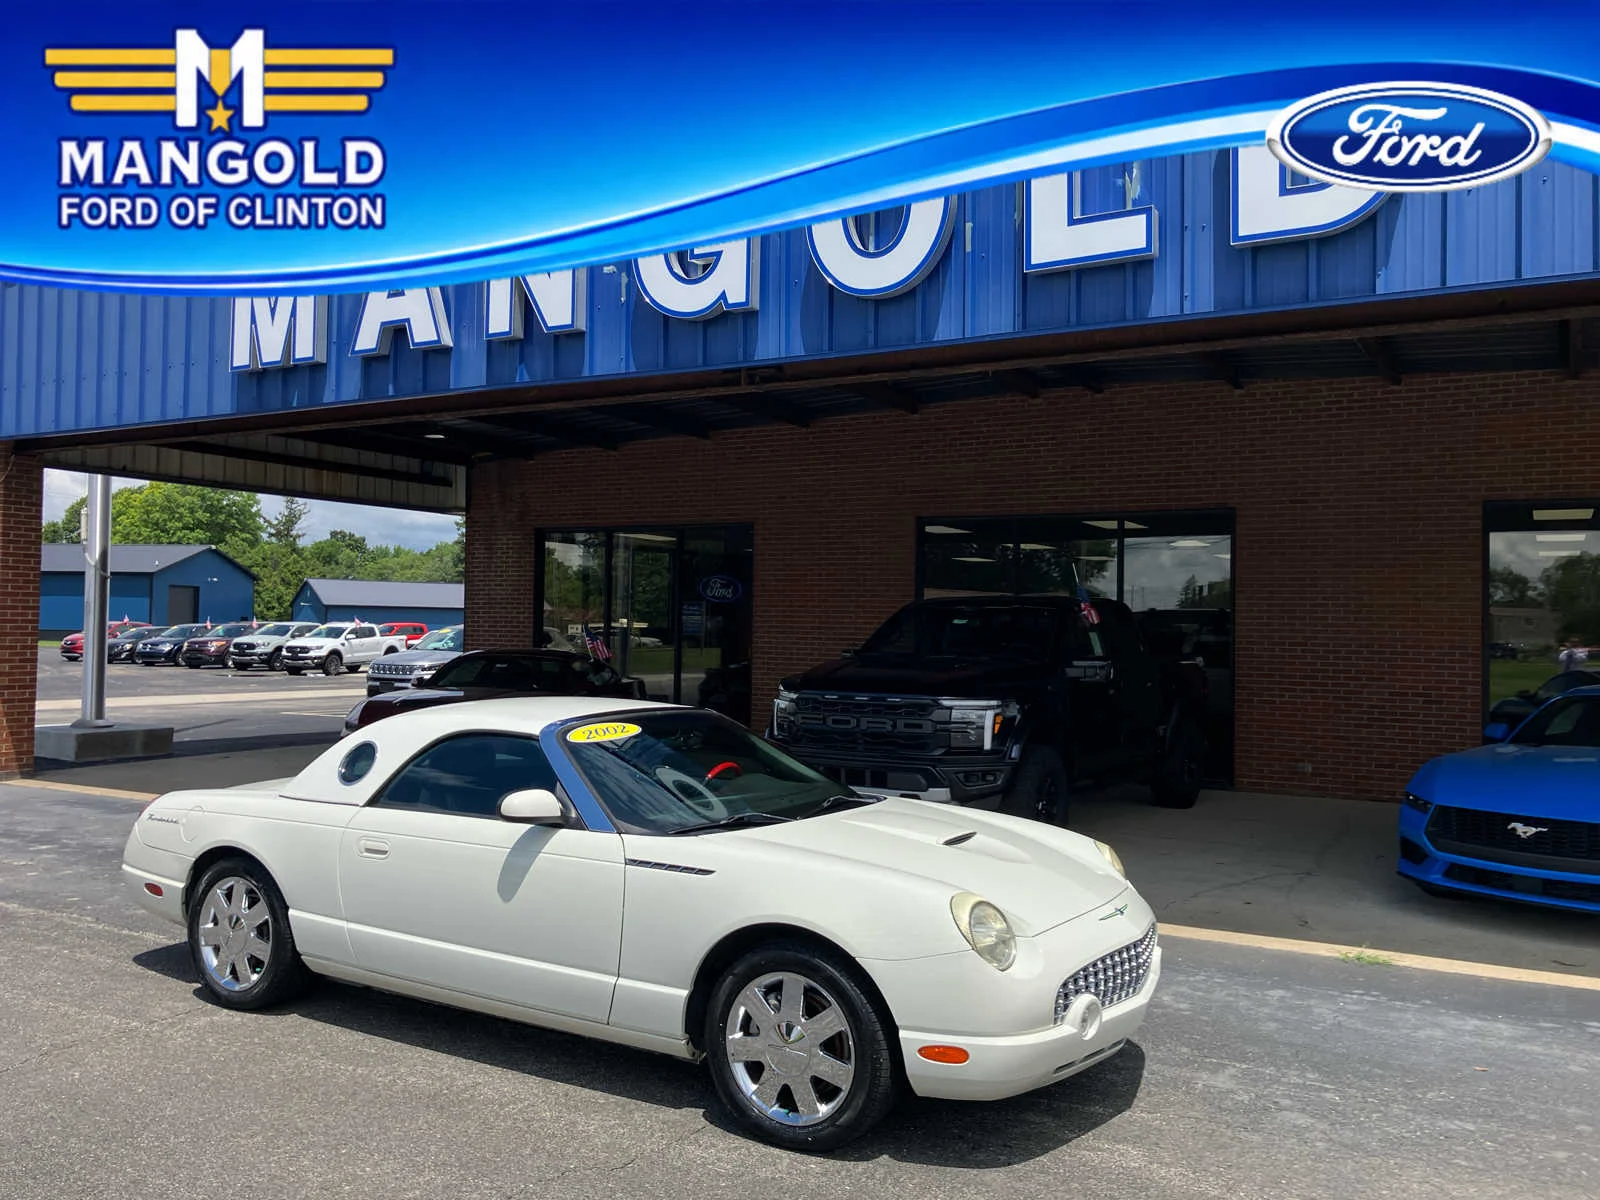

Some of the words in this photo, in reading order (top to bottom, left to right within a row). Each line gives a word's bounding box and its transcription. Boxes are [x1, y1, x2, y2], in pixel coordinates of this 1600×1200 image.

[706, 578, 735, 599] Ford
[581, 724, 630, 741] 2002
[794, 713, 936, 733] FORD
